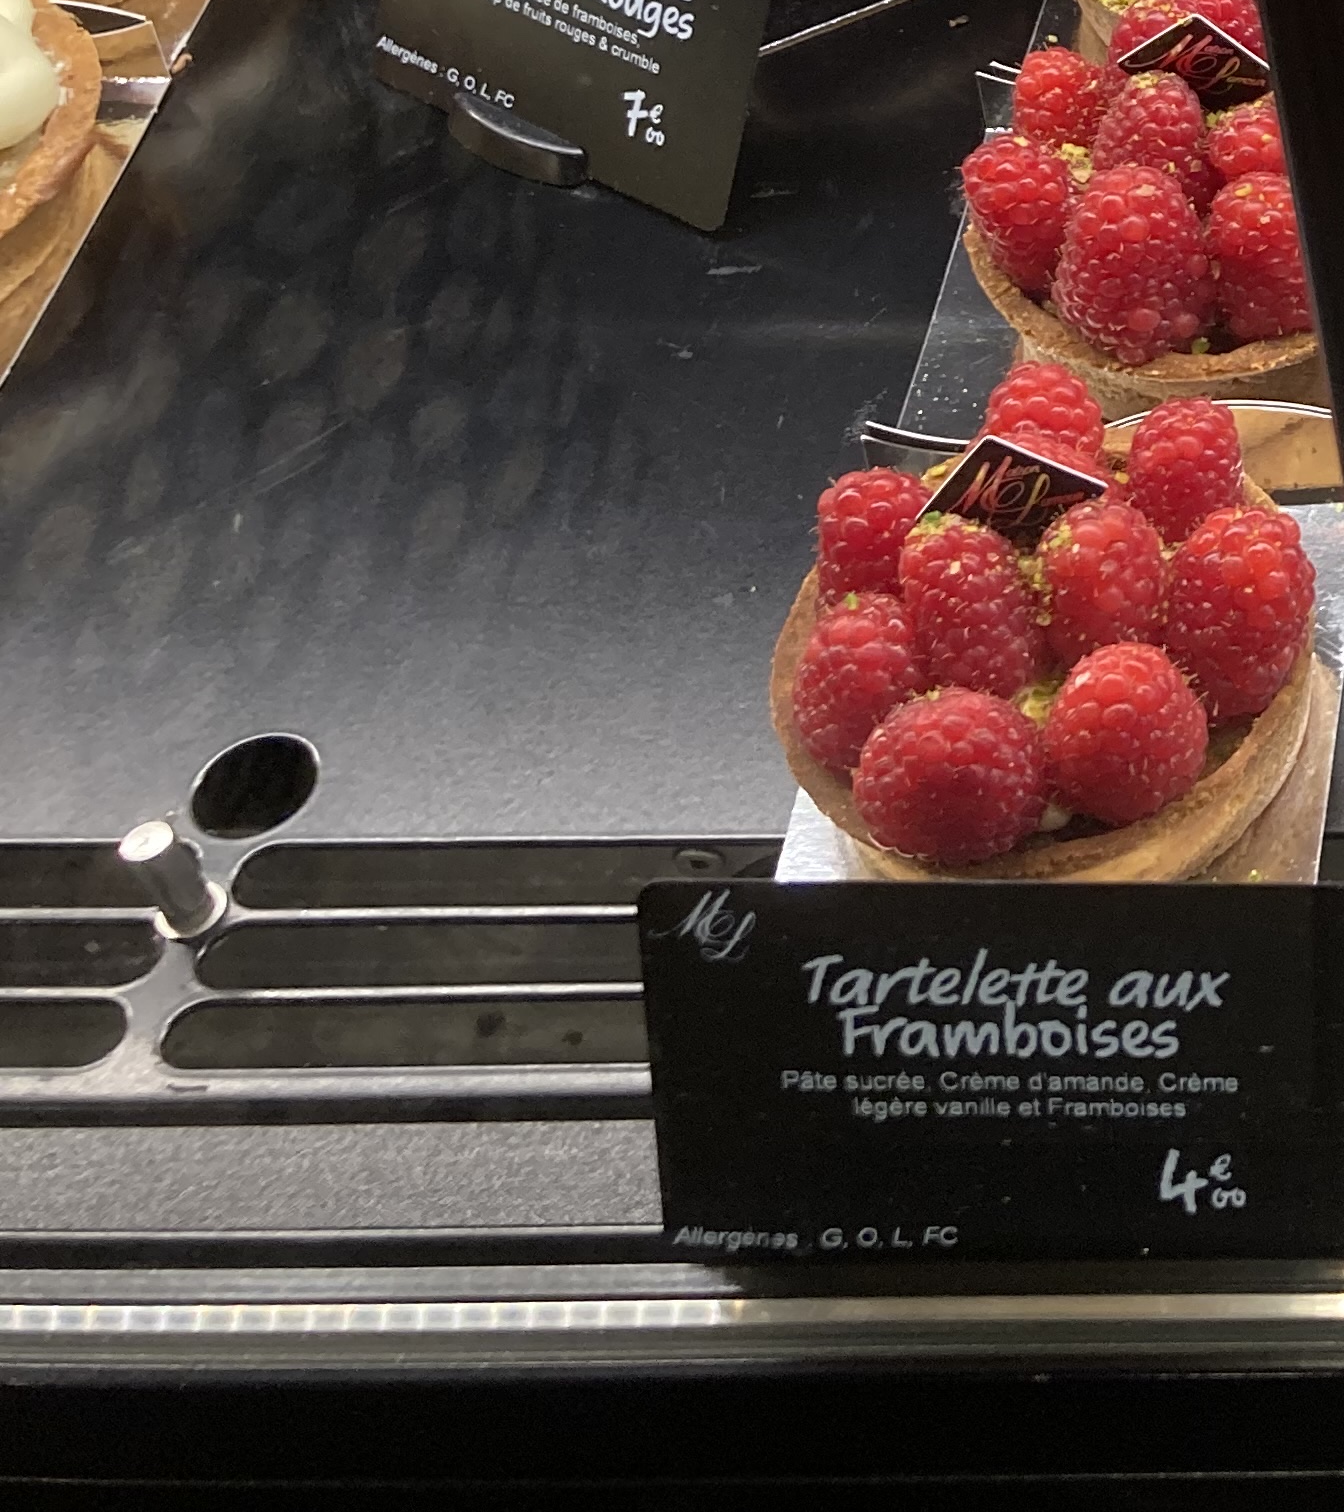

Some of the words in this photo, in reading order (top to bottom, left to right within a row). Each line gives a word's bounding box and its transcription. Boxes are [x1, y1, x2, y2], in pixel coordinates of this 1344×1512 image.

[522, 0, 553, 28] fruits
[554, 16, 598, 48] rouges
[598, 33, 610, 52] &
[610, 38, 662, 75] crumble
[376, 34, 438, 76] Allergènes
[495, 88, 516, 110] FC
[800, 948, 1089, 1009] Tartelette
[1108, 966, 1231, 1012] aux
[837, 1002, 1180, 1060] Framboises
[780, 1069, 839, 1092] Pâte
[939, 1070, 1021, 1093] Crème
[1157, 1071, 1240, 1094] Crème
[852, 1096, 929, 1123] légère
[934, 1096, 1011, 1119] vanille
[1018, 1097, 1042, 1119] et
[1048, 1096, 1187, 1120] Framboises
[672, 1224, 799, 1252] Allergènes
[922, 1225, 959, 1247] FC
